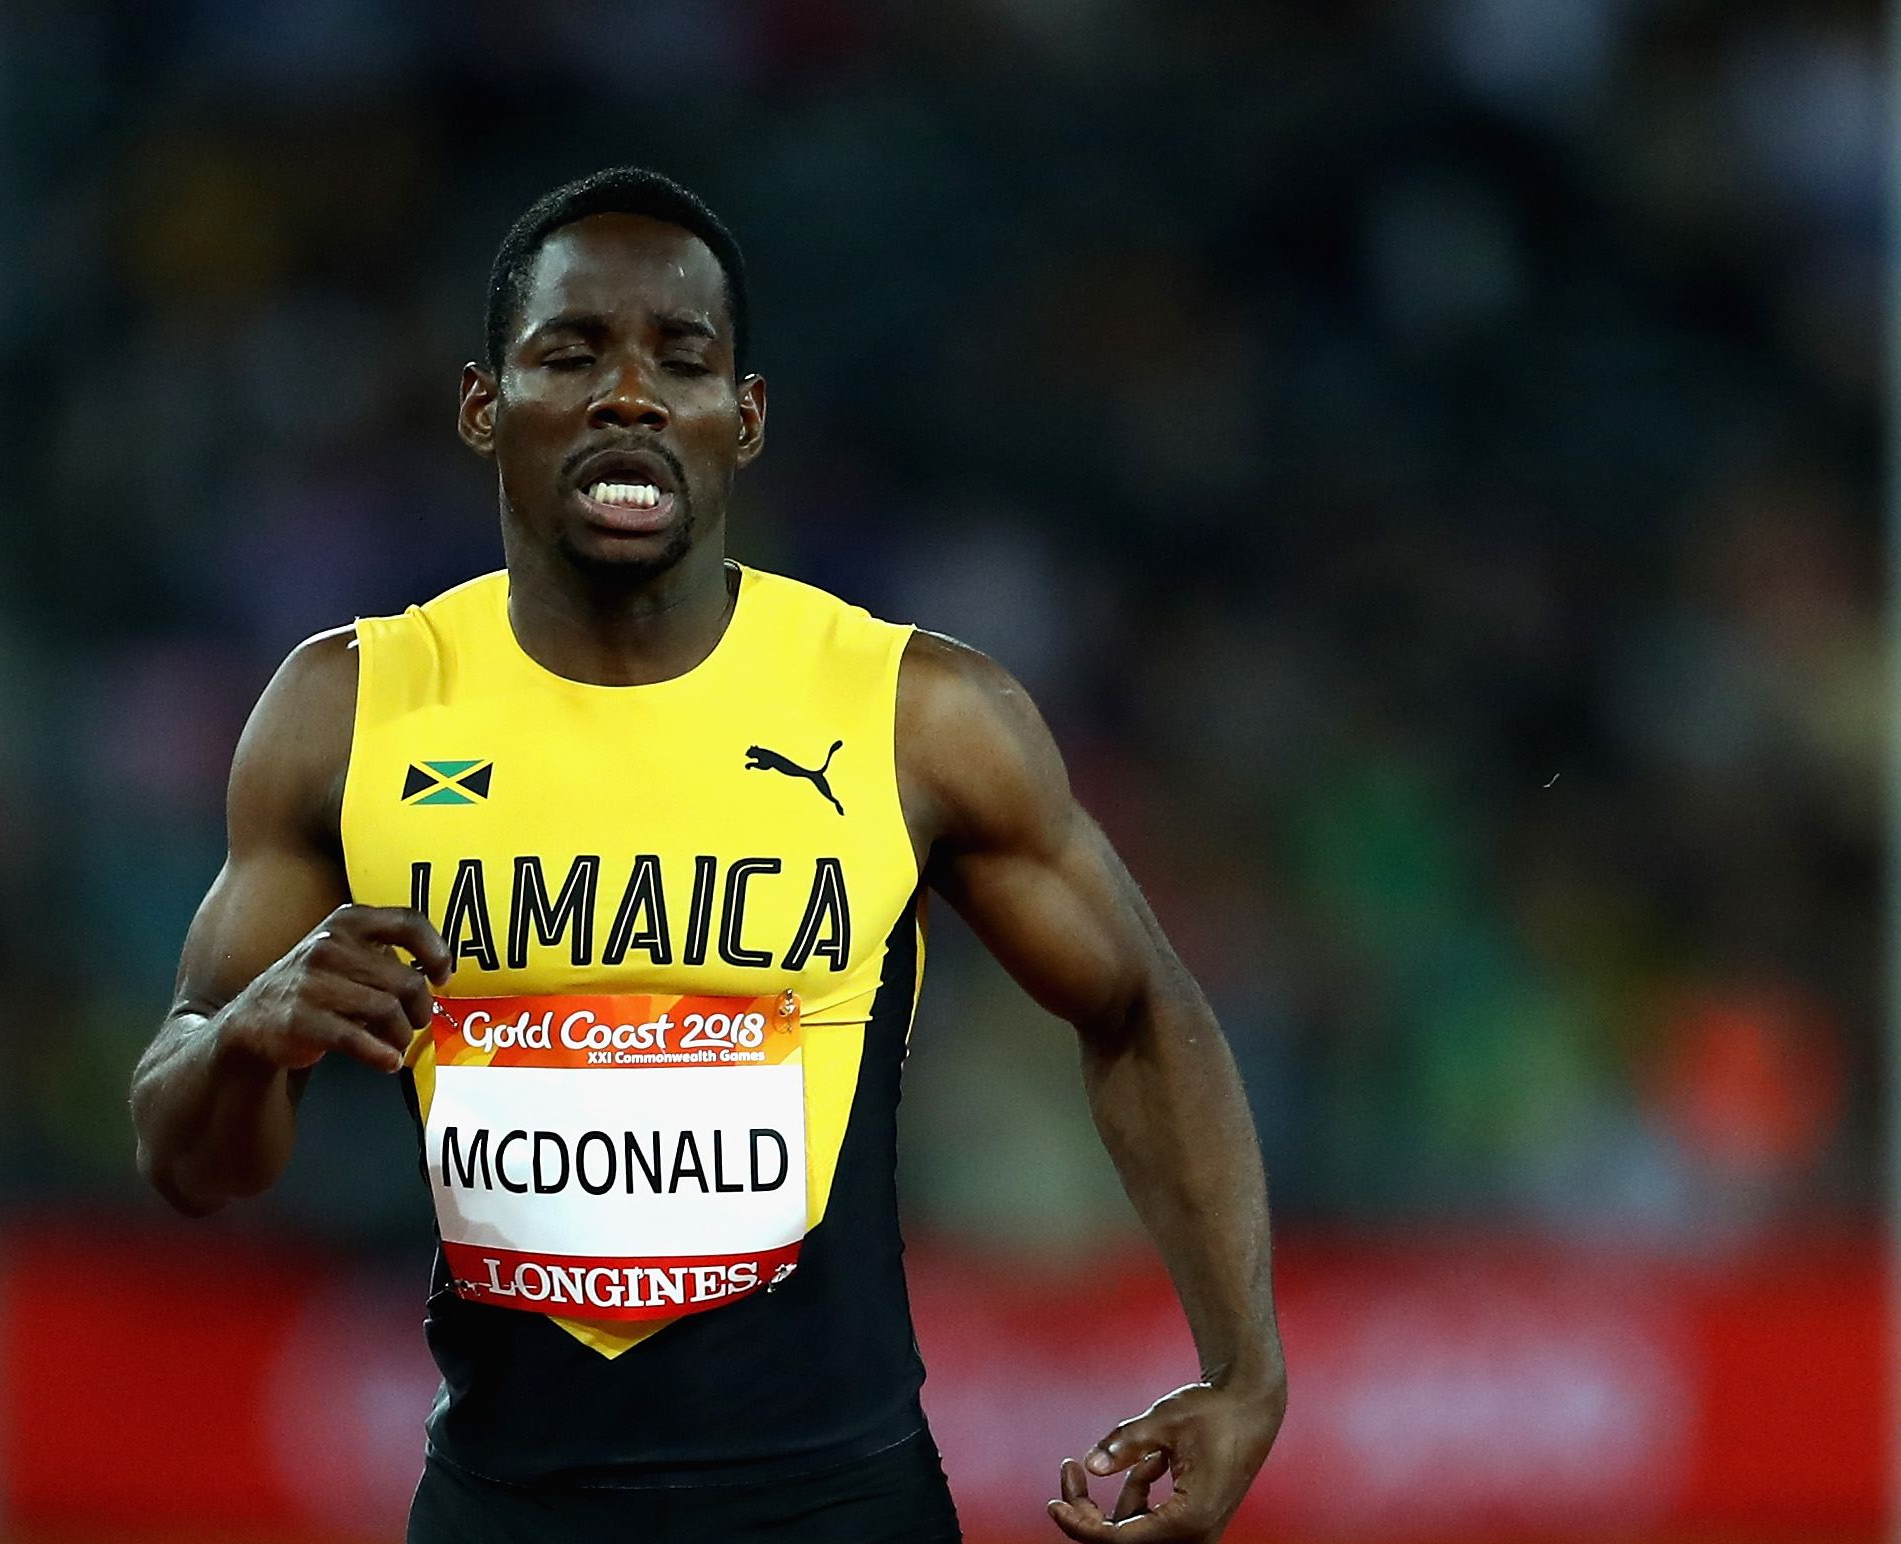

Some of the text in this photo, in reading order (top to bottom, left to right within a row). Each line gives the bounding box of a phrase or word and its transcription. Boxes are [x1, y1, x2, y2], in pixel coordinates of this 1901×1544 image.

[462, 1010, 767, 1053] Gold Coast 2018
[587, 1049, 767, 1065] XXI Commonwealth Games
[441, 1126, 789, 1196] MCDONALD
[482, 1257, 760, 1308] LONGINES
